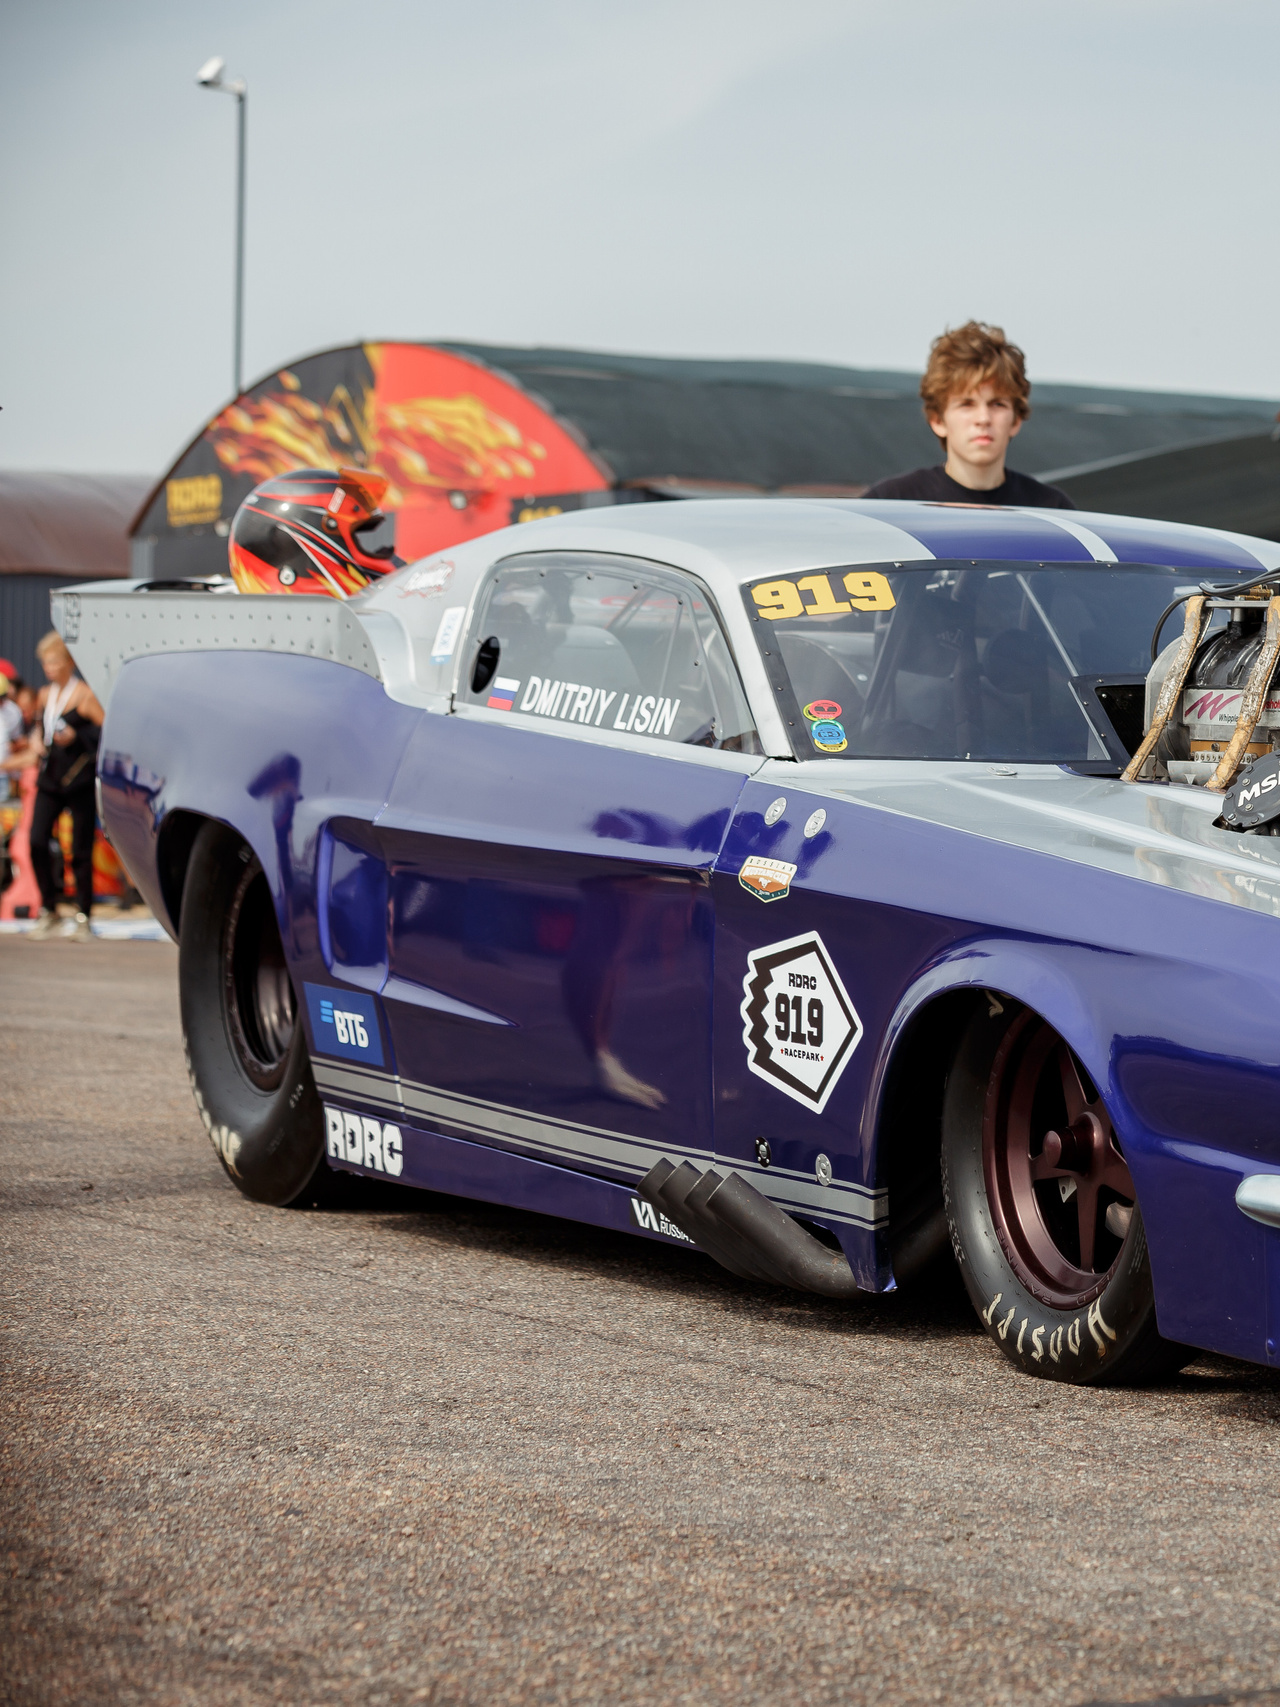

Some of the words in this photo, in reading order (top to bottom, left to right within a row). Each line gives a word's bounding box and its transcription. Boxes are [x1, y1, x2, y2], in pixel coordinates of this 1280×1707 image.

[750, 571, 897, 621] 919
[519, 675, 618, 726] DMITRIY
[612, 692, 681, 736] LISIN
[749, 858, 794, 872] RUSSIAN
[788, 972, 817, 990] RDRC
[333, 1009, 369, 1048] ВТБ
[774, 992, 824, 1047] 919
[784, 1048, 820, 1062] RACEPARK
[323, 1106, 404, 1177] RDRC
